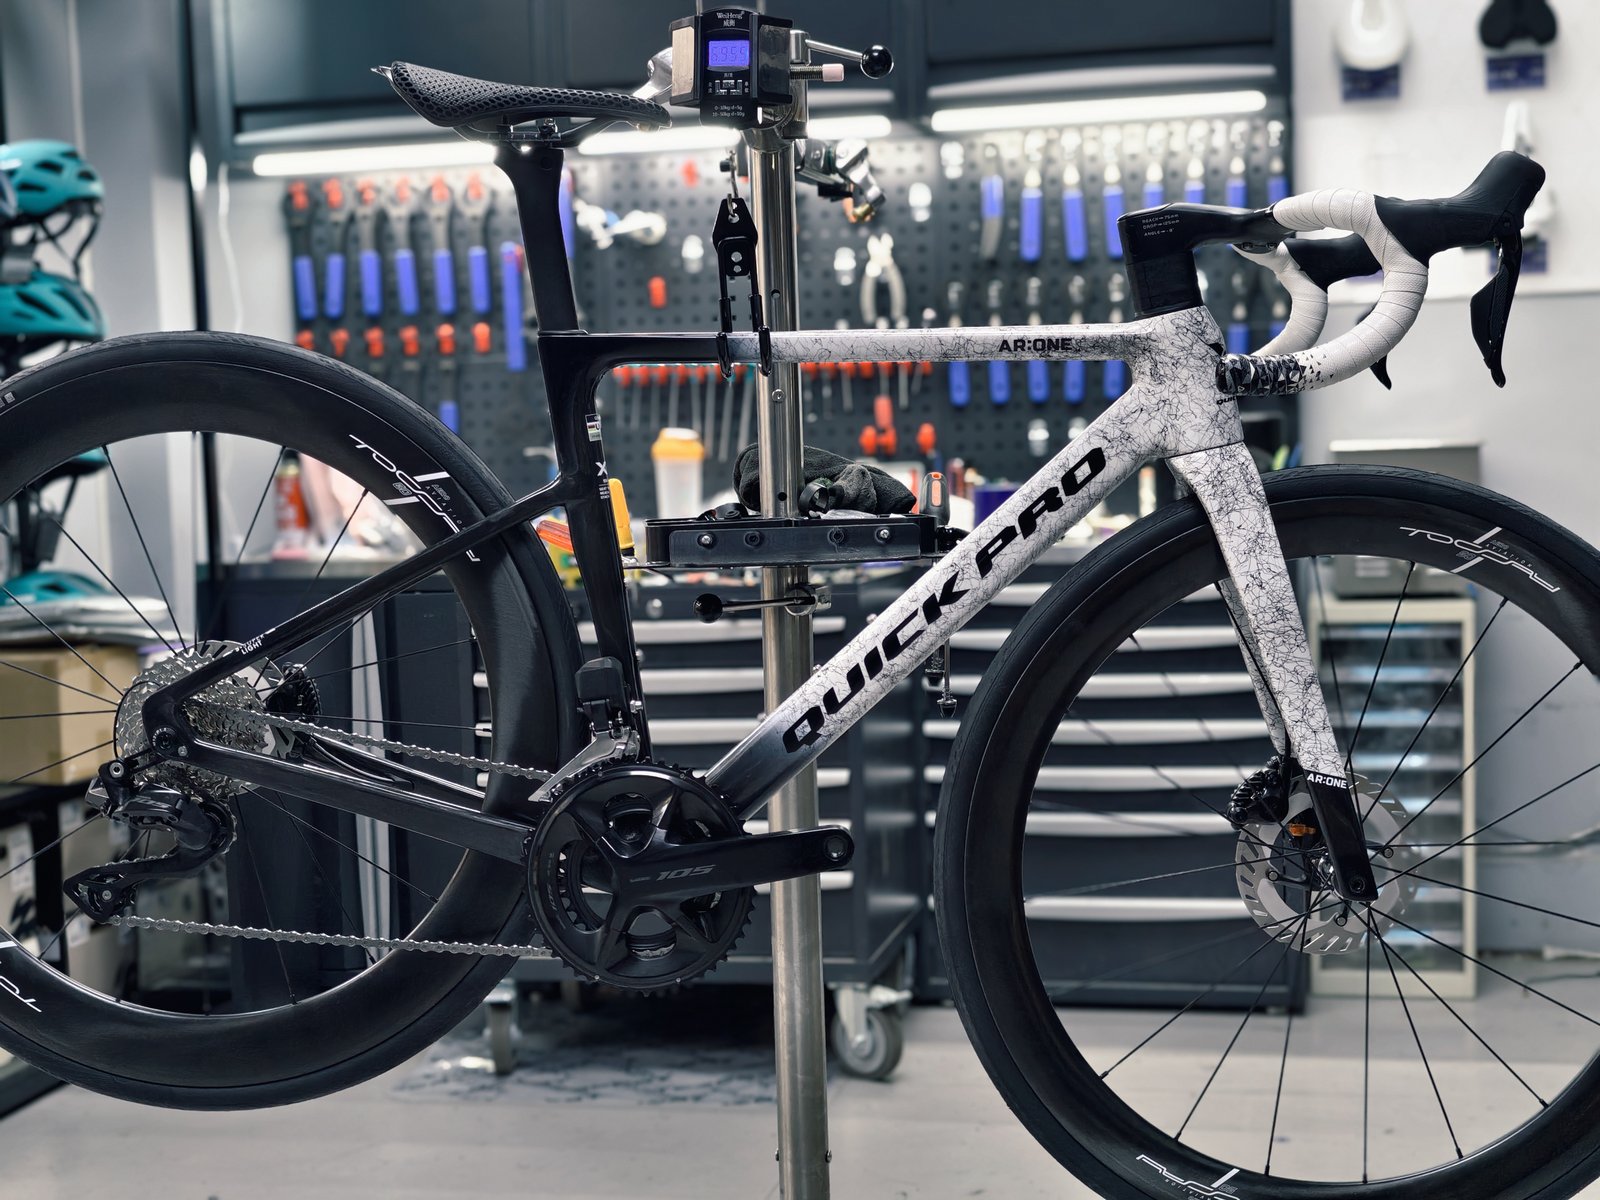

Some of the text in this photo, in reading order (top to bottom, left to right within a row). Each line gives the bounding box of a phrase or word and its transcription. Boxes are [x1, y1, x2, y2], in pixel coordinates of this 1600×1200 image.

[999, 338, 1073, 353] AR:ONE
[782, 446, 1106, 754] QUICK PRO
[240, 639, 263, 655] LIGHT
[1306, 772, 1348, 790] AR:ONE
[656, 864, 717, 881] 105
